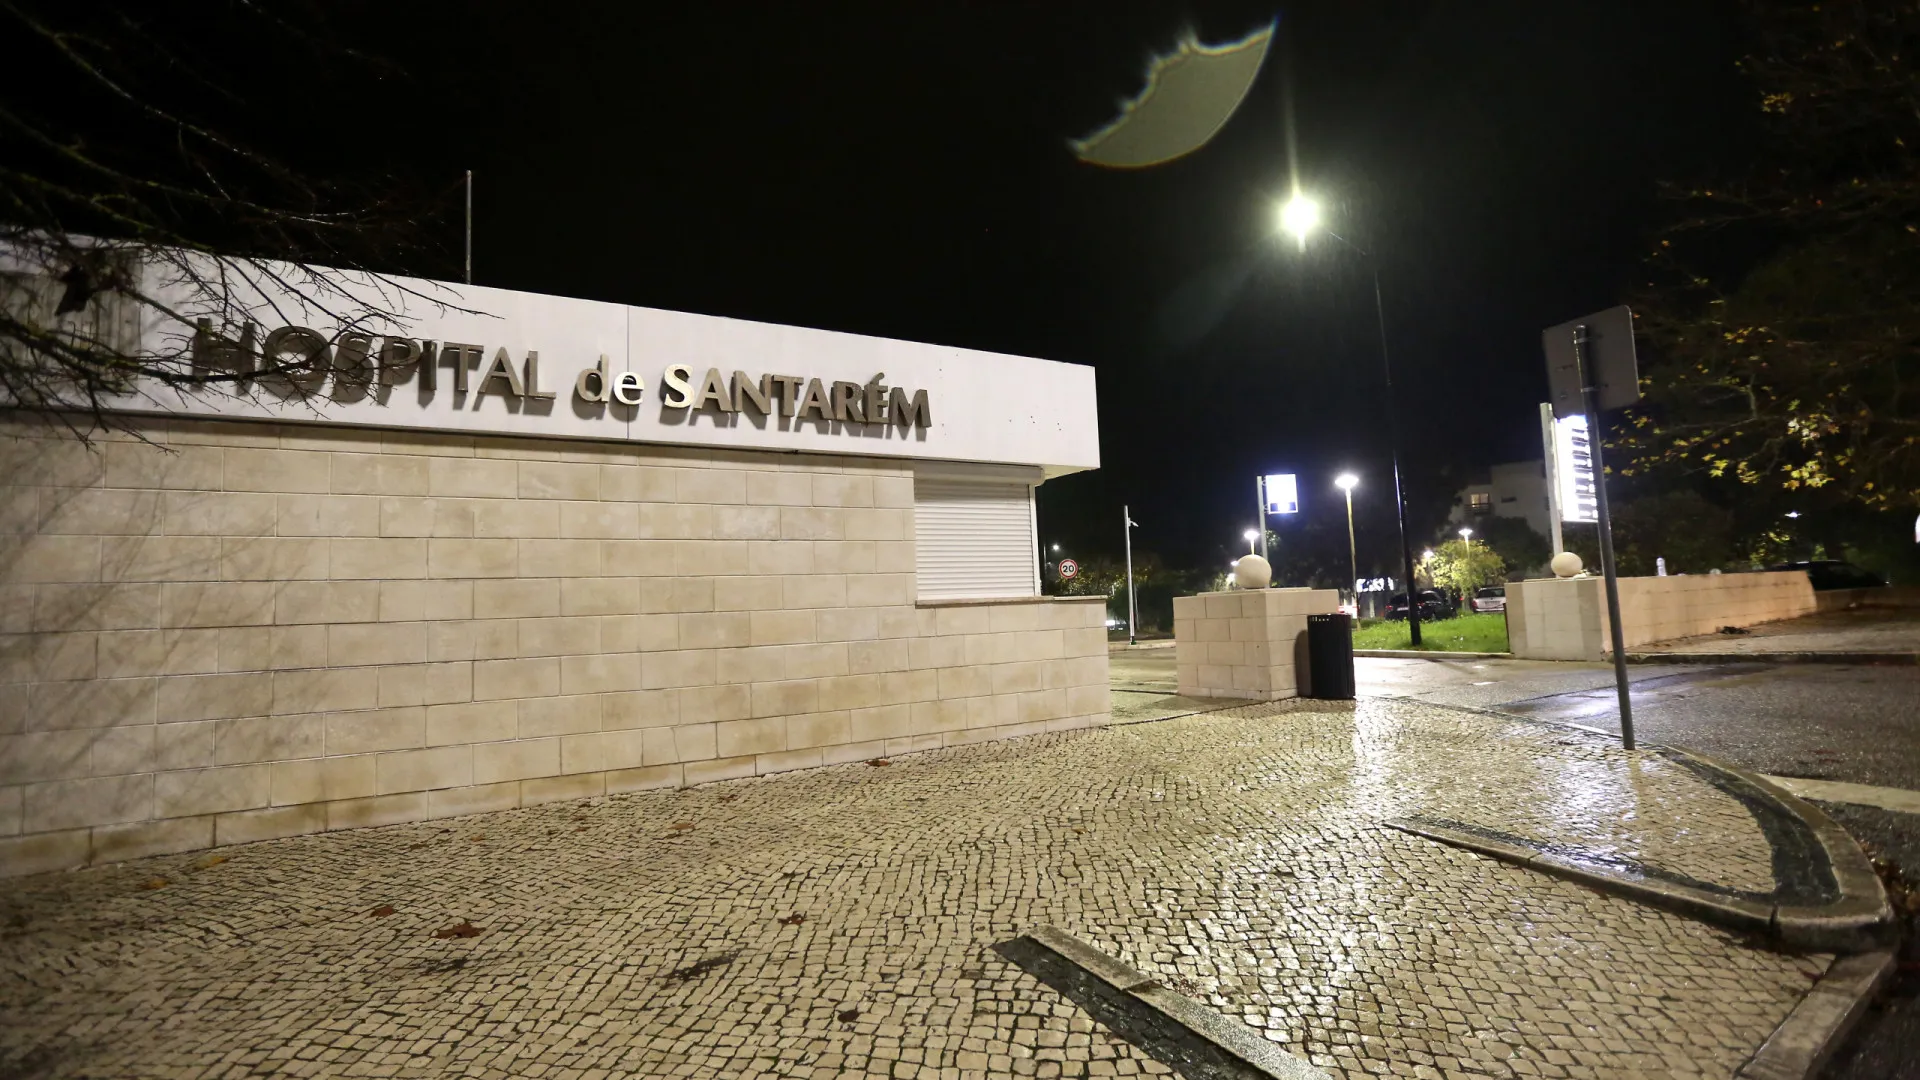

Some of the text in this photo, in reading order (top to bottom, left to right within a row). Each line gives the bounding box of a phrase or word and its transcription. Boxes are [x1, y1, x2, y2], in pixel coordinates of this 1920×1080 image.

[194, 317, 932, 428] HOSPITAL de SANTARÉM
[1062, 565, 1075, 573] 20
